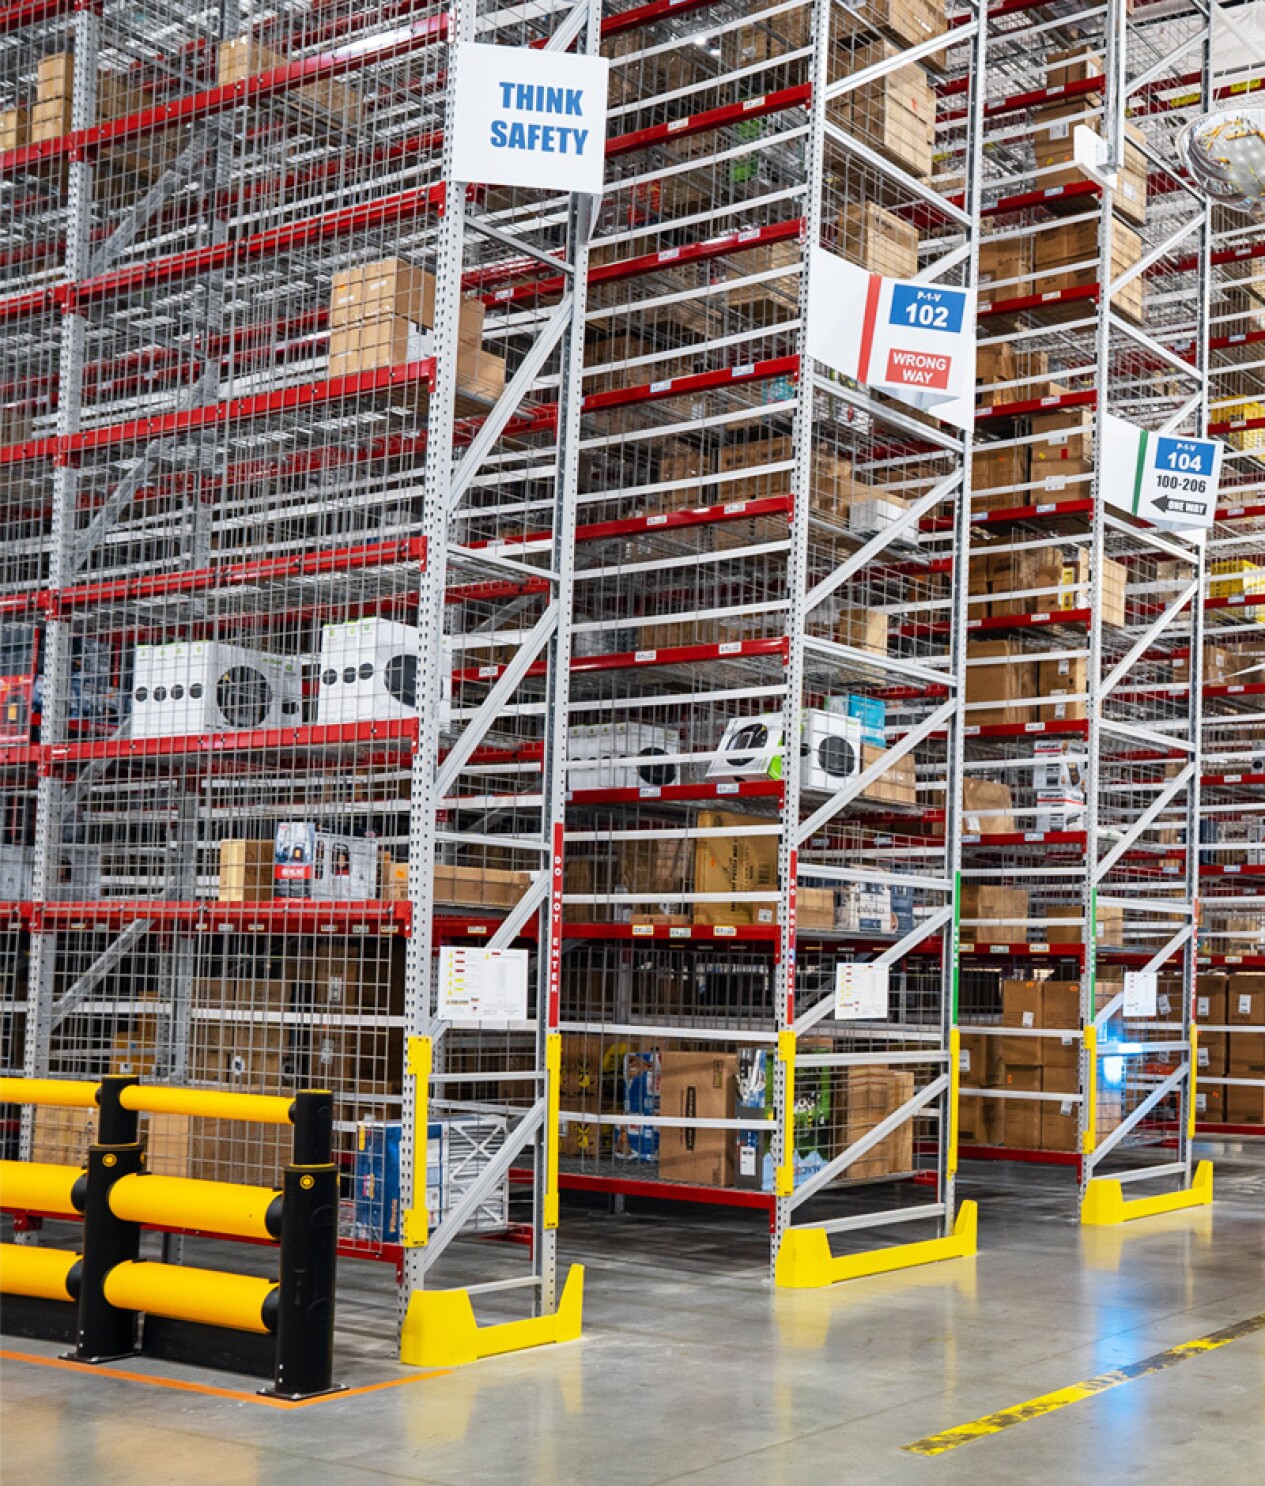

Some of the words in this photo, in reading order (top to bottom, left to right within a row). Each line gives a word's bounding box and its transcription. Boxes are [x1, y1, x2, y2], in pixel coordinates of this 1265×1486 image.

[499, 81, 584, 116] THINK
[490, 119, 589, 155] SAFETY
[917, 291, 942, 302] P-1-V
[905, 303, 950, 328] 102
[892, 352, 947, 371] WRONG
[902, 368, 934, 384] WAY
[1168, 452, 1202, 471] 104
[1156, 475, 1207, 493] 100-206
[1185, 502, 1206, 513] WAY
[554, 856, 562, 877] DO
[553, 891, 562, 922] NOT
[551, 936, 560, 993] ENTER
